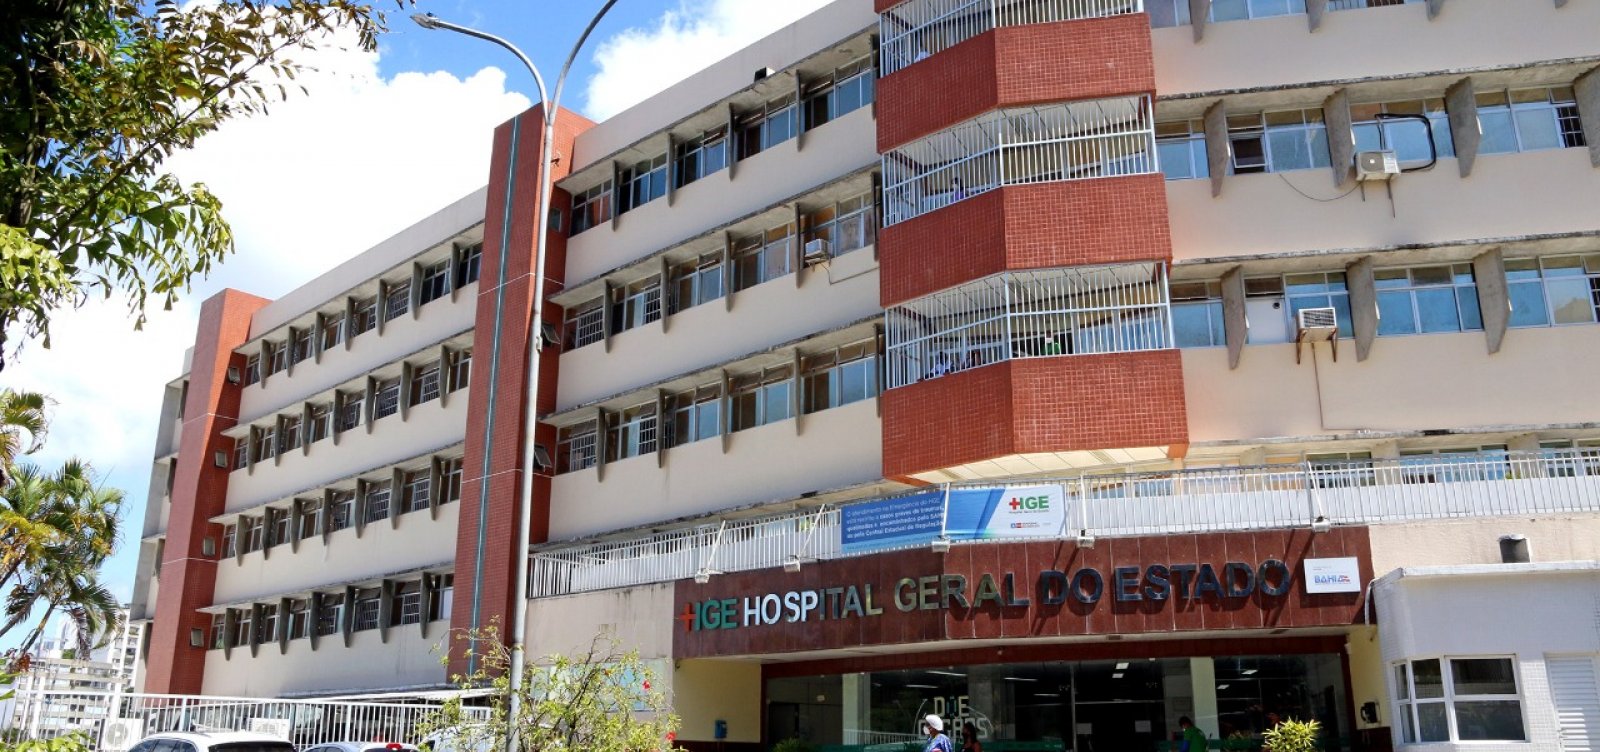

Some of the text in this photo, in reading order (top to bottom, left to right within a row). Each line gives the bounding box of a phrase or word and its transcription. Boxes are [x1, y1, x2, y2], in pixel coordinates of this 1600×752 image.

[744, 583, 883, 627] HOSPITAL
[894, 572, 1030, 612] GERAL
[1040, 567, 1104, 605] DO
[1114, 559, 1290, 601] ESTADO
